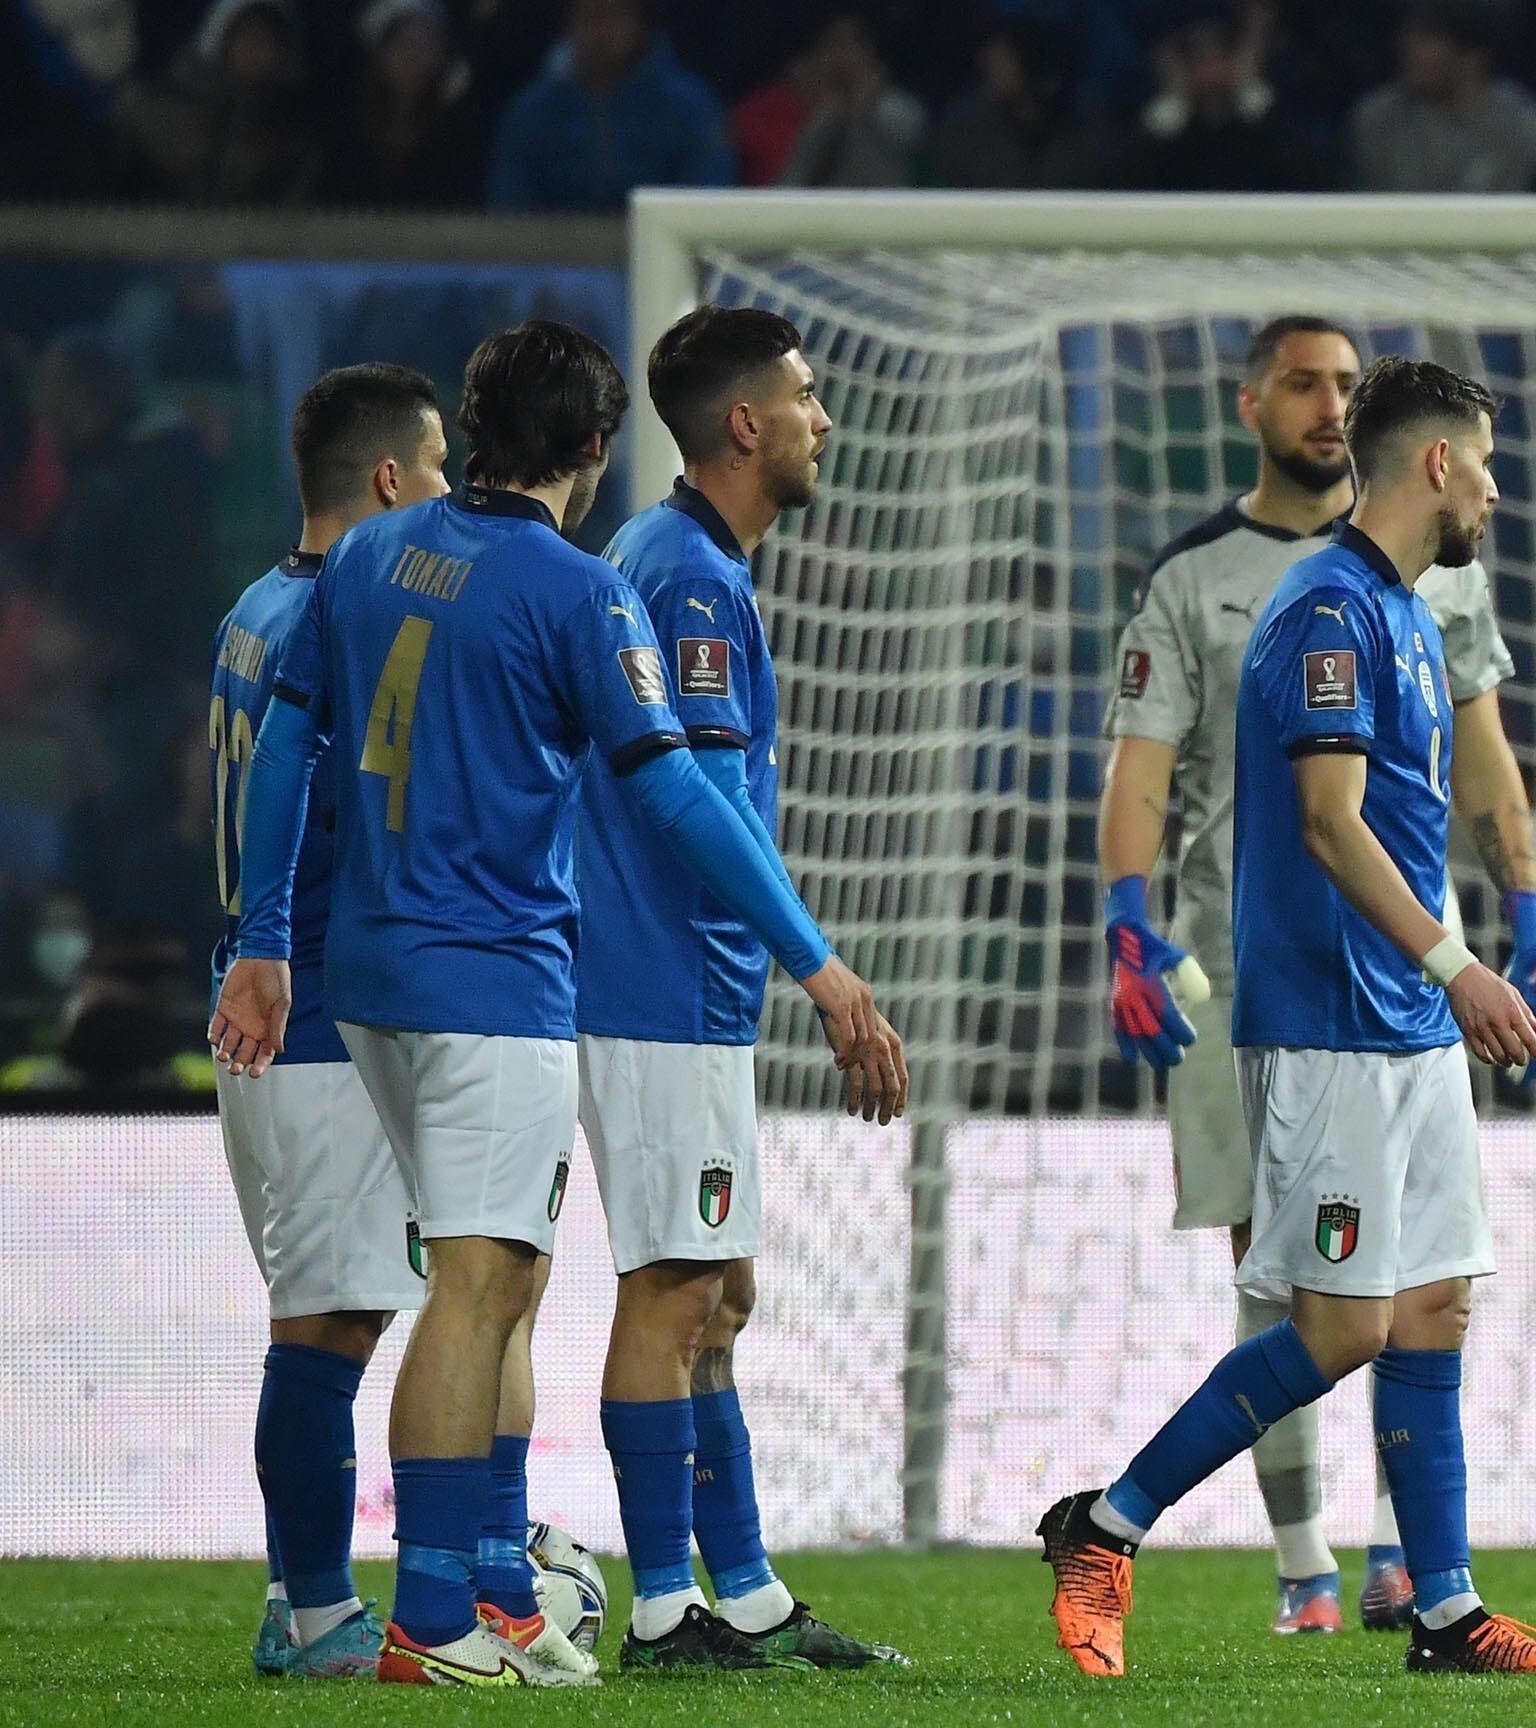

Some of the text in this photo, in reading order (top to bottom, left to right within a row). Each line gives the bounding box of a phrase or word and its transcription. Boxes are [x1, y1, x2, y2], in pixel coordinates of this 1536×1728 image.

[390, 544, 474, 602] TONALI
[360, 614, 434, 833] 4
[1320, 1207, 1357, 1220] ITALIA
